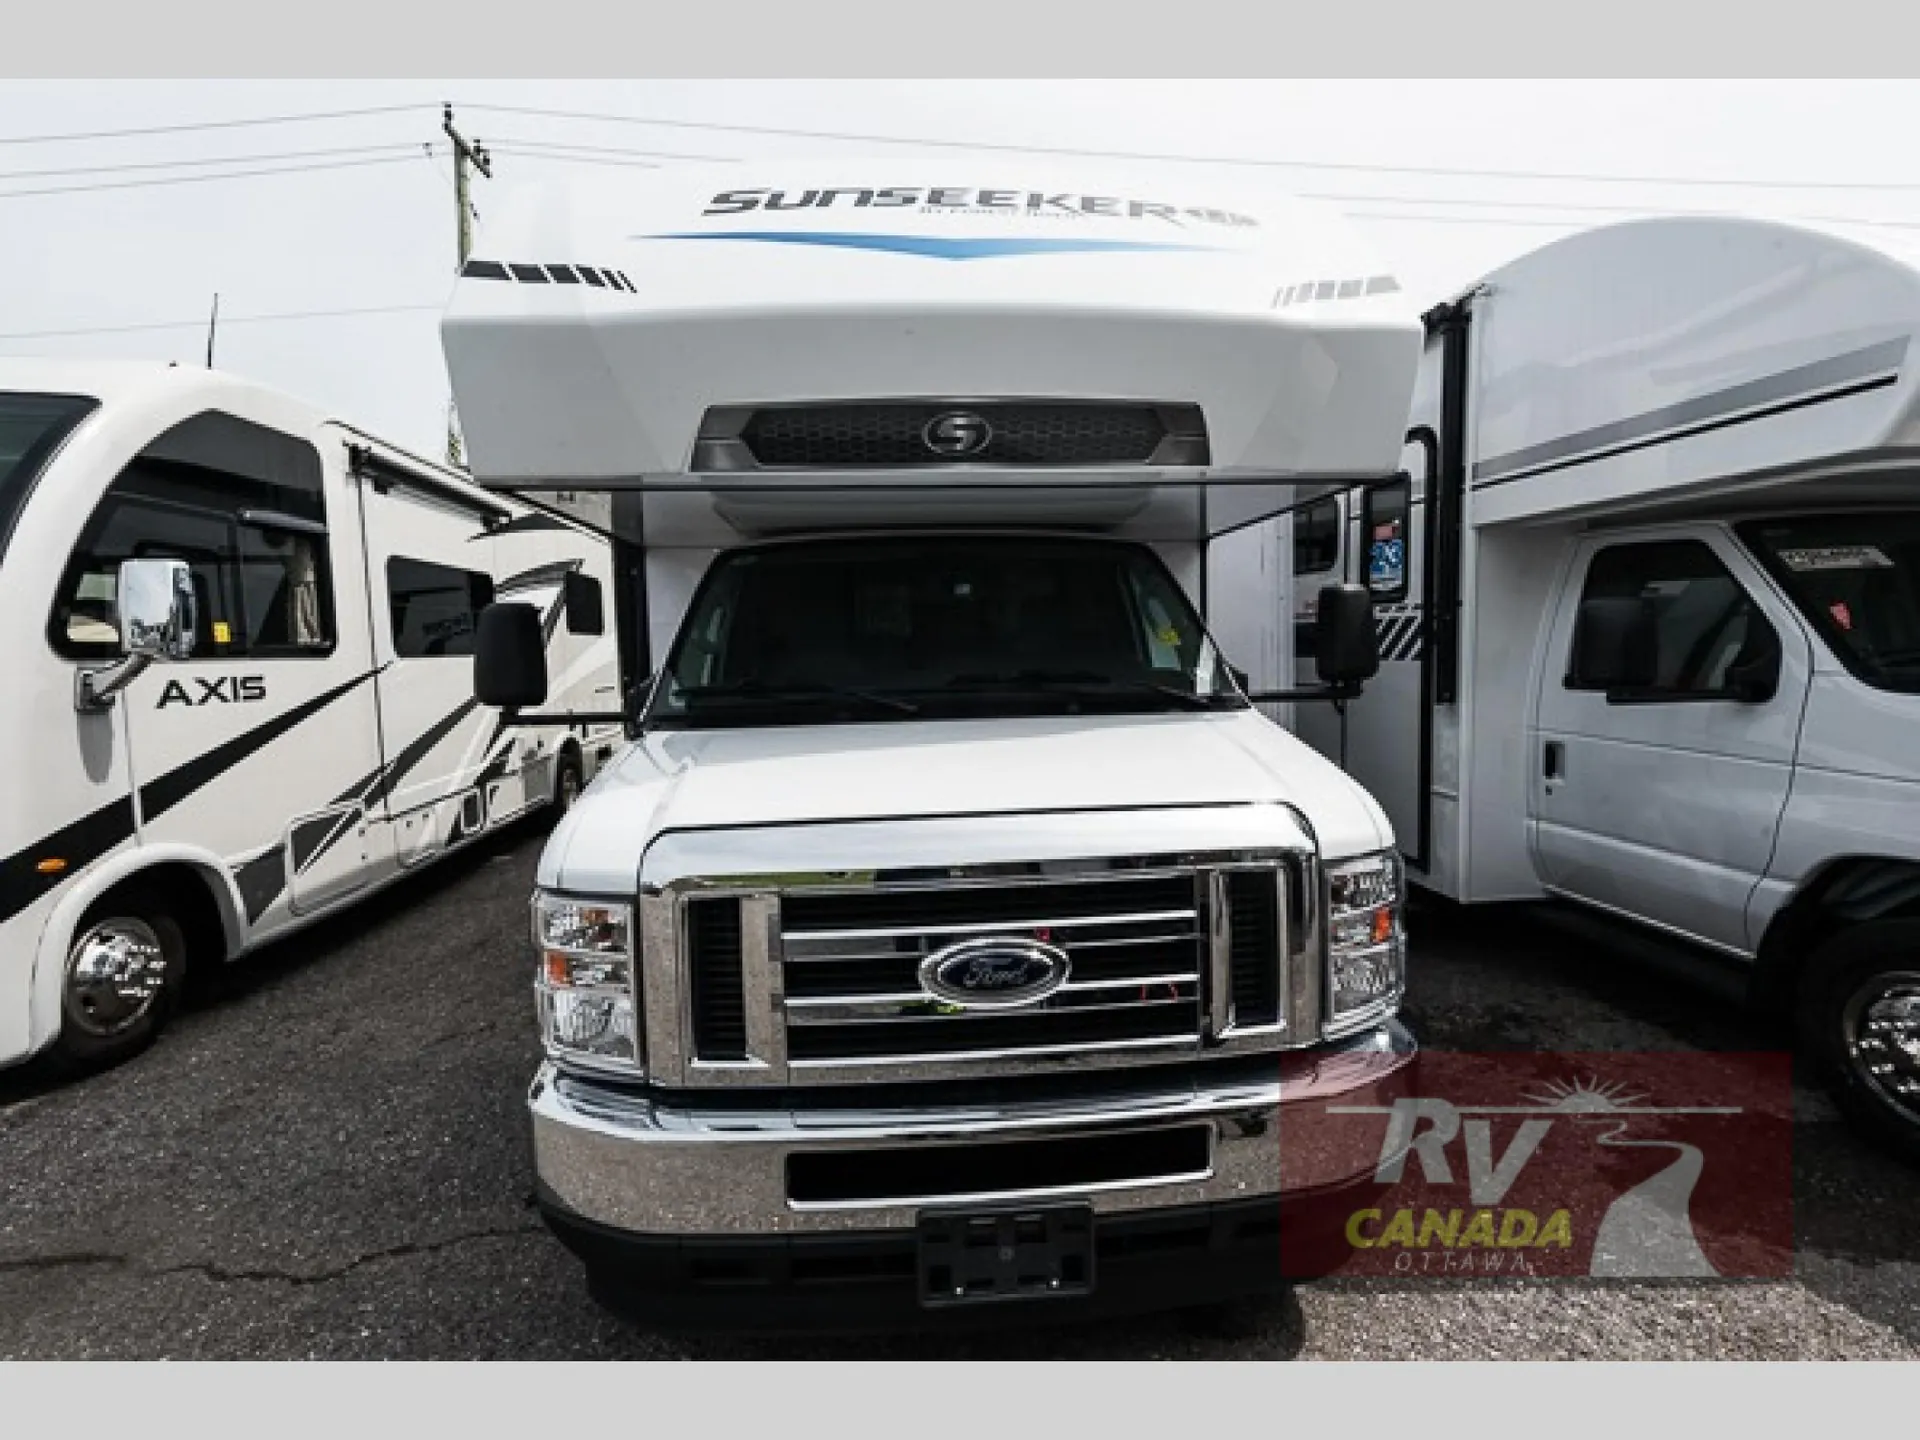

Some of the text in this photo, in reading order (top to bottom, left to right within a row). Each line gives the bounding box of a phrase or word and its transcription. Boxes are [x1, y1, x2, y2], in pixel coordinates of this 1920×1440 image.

[702, 187, 1187, 227] SUNSEEKER
[155, 675, 267, 709] AXIS
[962, 957, 1029, 987] Ford
